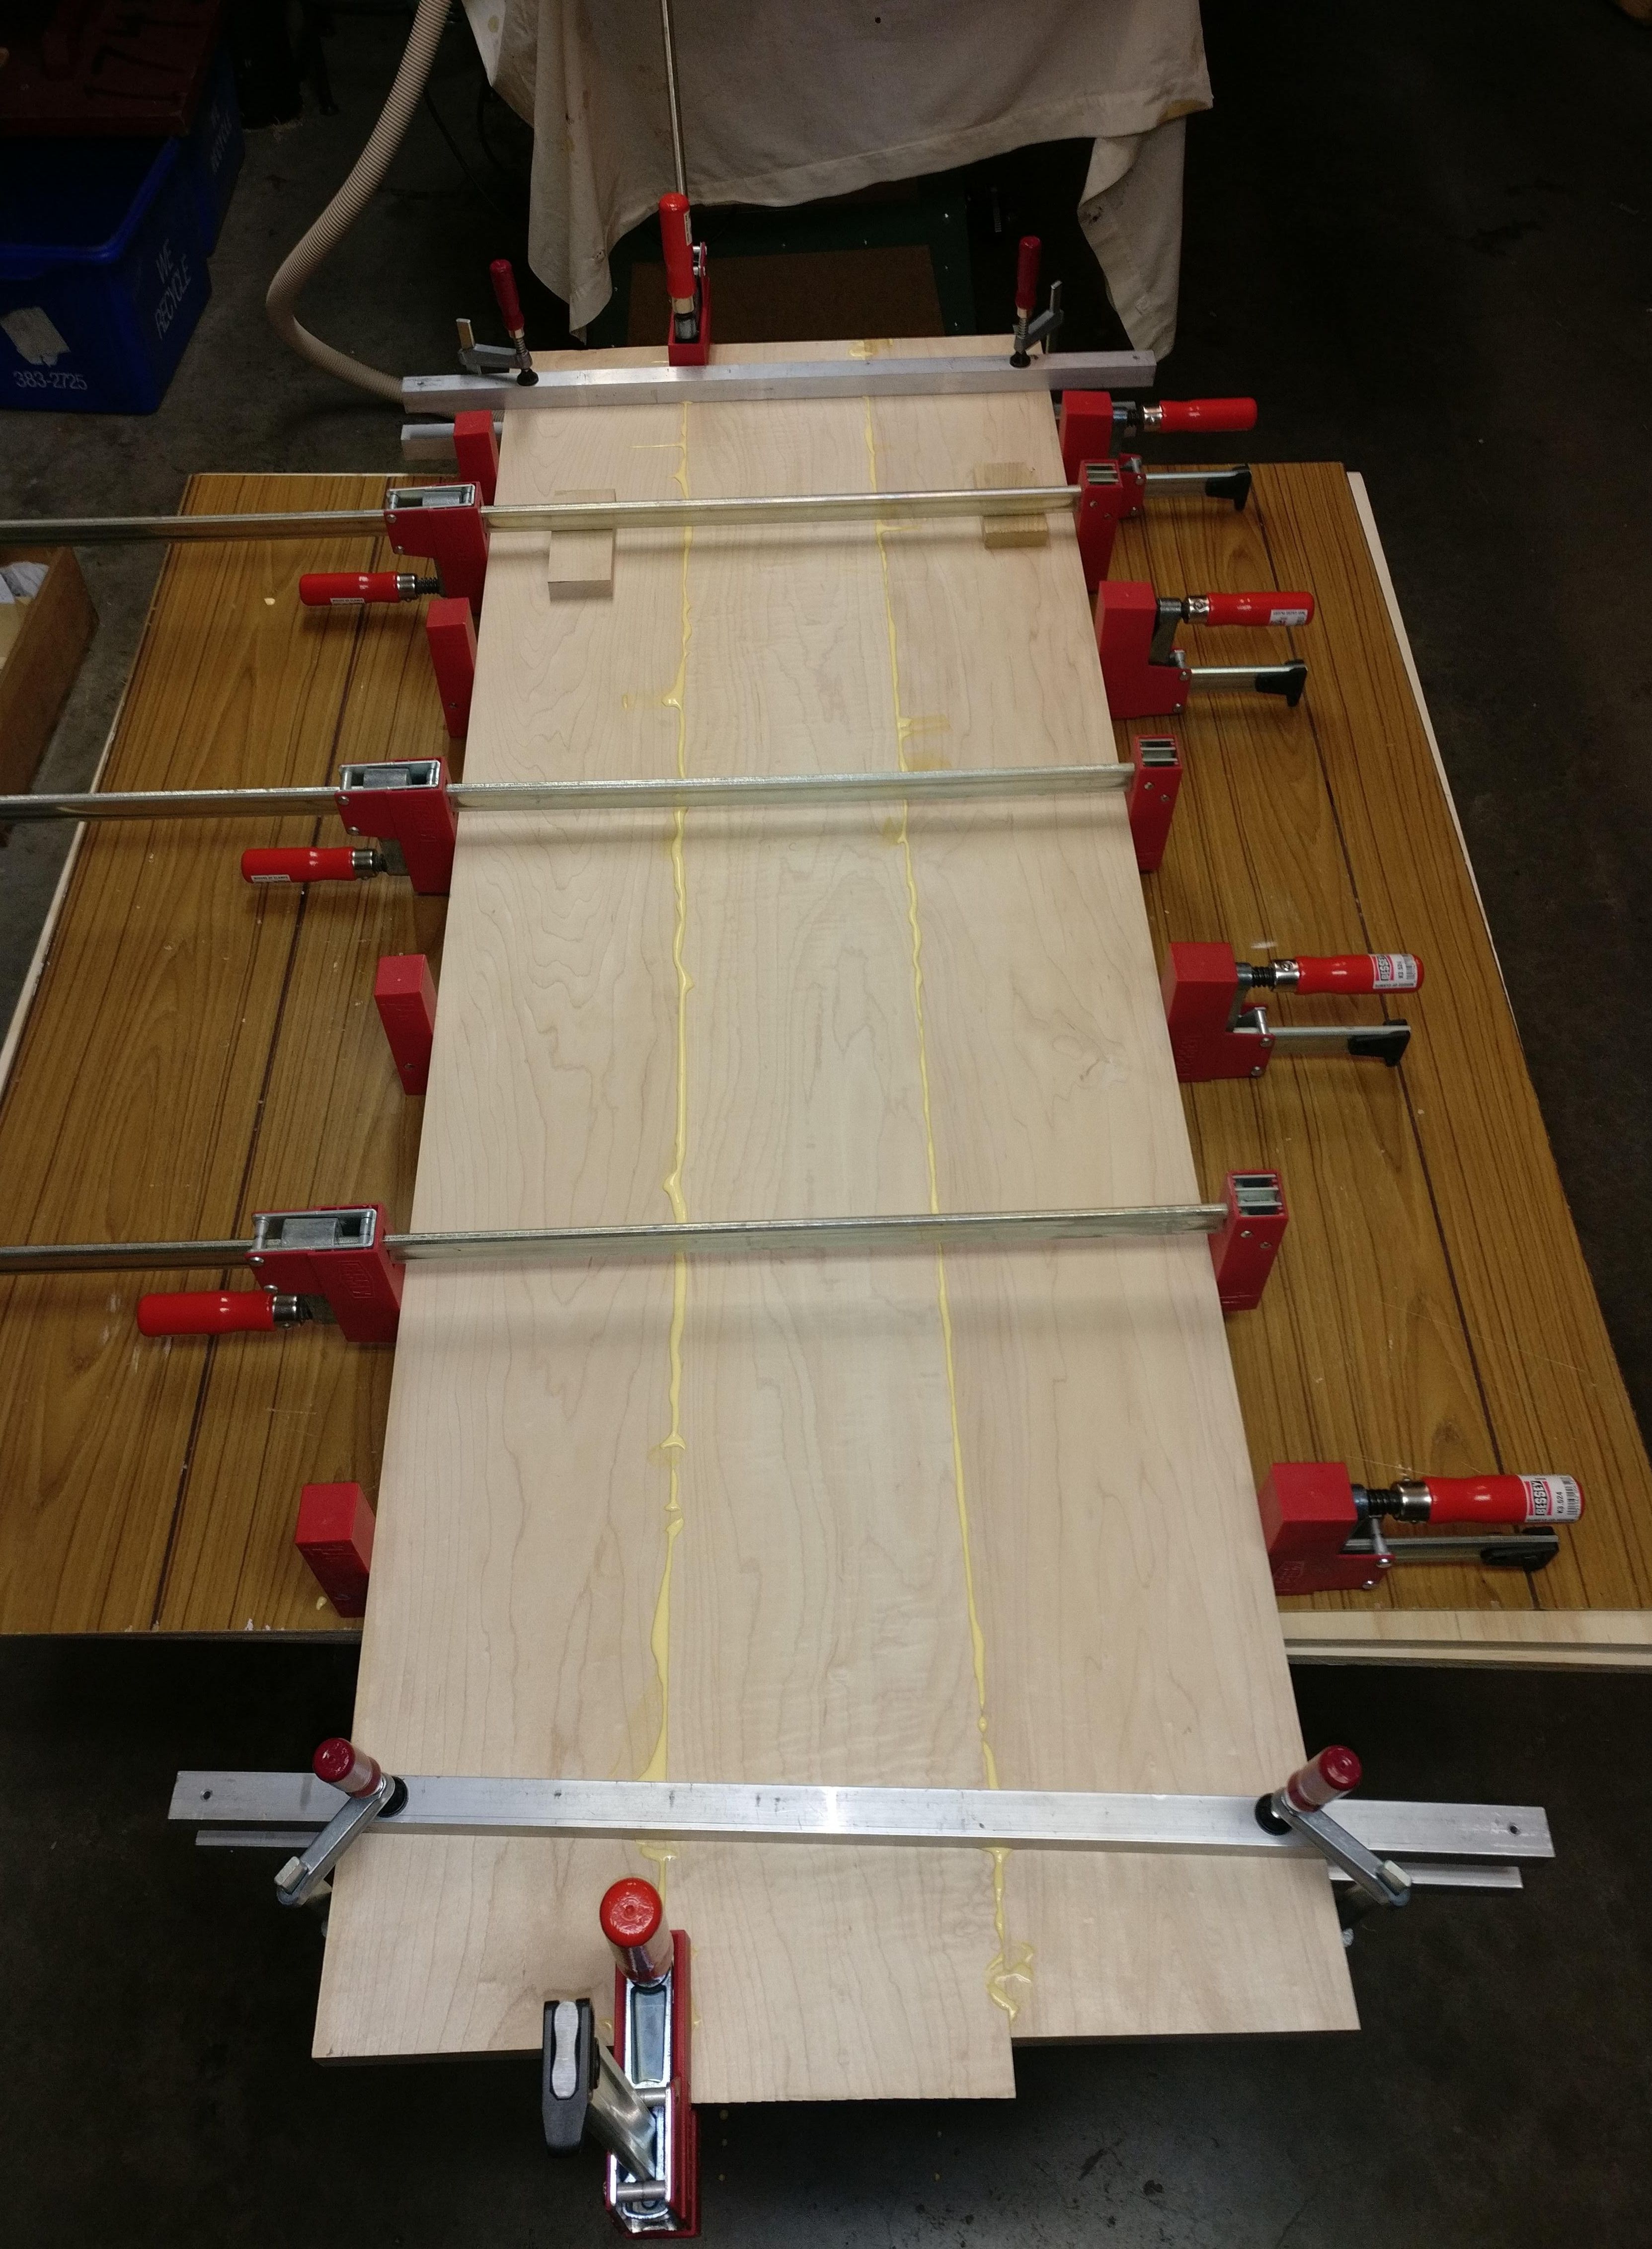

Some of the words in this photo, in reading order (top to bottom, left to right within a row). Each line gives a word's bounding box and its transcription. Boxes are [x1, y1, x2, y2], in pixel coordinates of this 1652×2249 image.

[156, 238, 173, 284] WE
[155, 253, 191, 341] RECYCLE
[13, 371, 88, 390] 383-2725
[1377, 954, 1390, 981] BESSE
[1531, 1480, 1548, 1515] BESSEY
